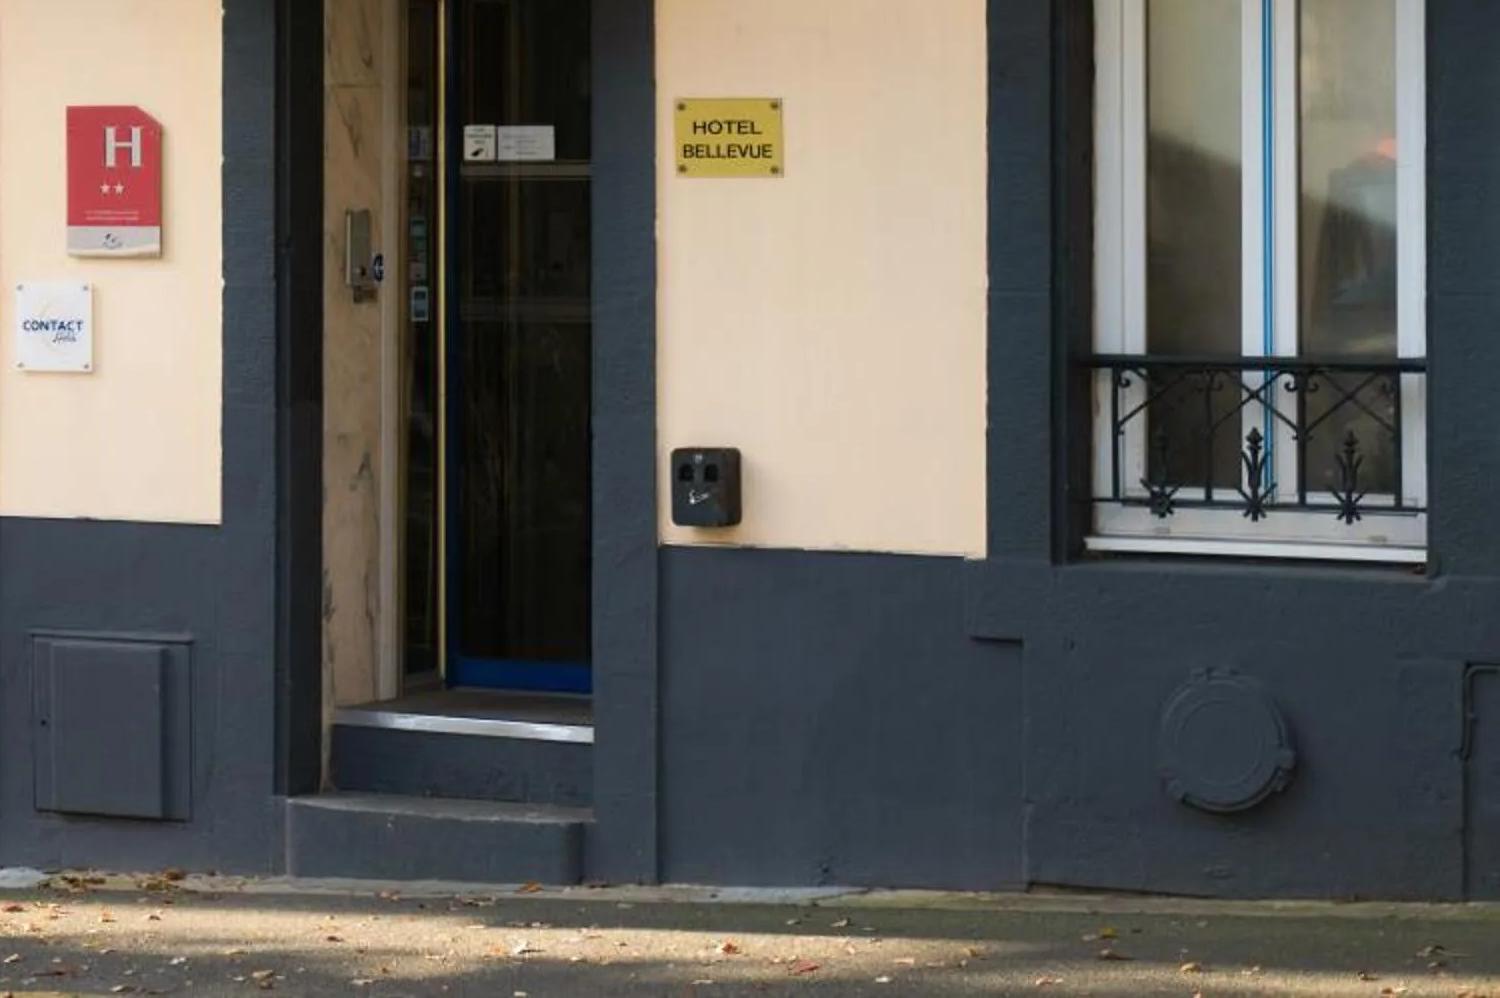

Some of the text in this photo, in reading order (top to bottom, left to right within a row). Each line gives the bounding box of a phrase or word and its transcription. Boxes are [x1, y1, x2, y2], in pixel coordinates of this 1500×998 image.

[105, 126, 142, 167] H
[682, 143, 773, 159] BELLEVUE
[22, 319, 83, 331] CONTACT
